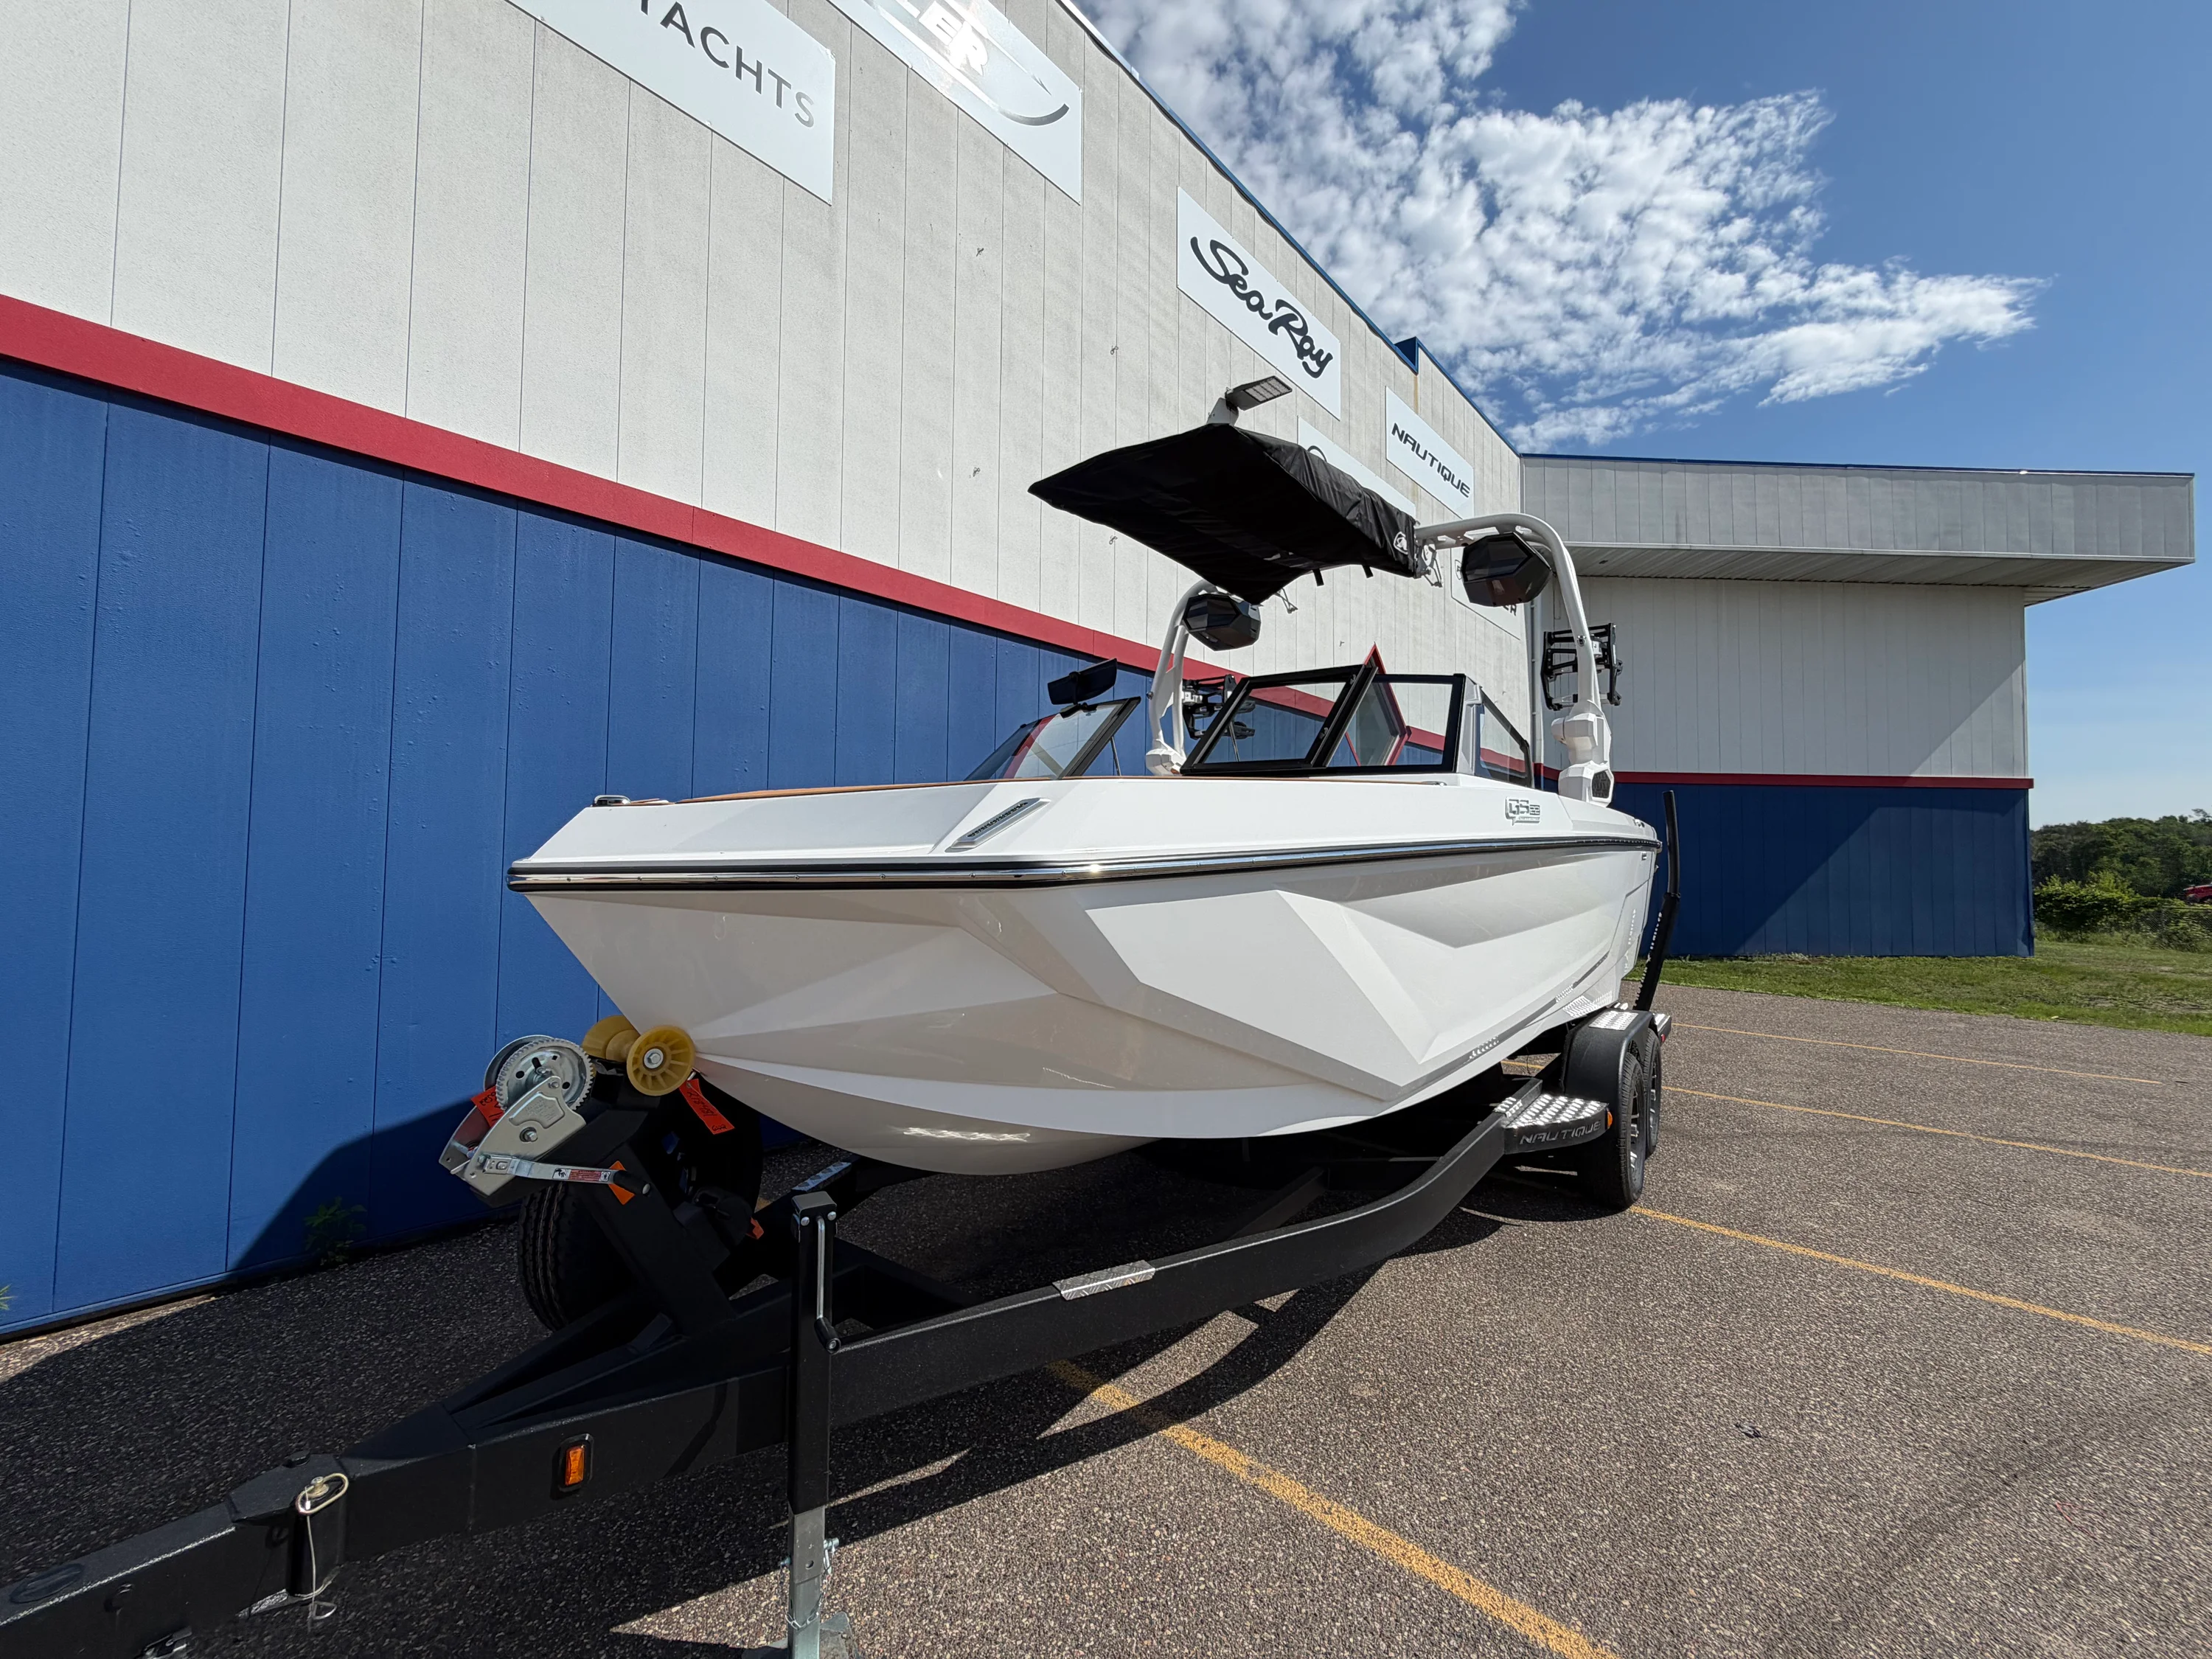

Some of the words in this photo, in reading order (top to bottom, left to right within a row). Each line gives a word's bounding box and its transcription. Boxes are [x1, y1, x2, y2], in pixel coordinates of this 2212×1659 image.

[641, 0, 815, 128] ACHTS
[1190, 237, 1273, 320] Sea
[1268, 299, 1333, 378] Ray
[1391, 422, 1471, 498] NAUTIQUE
[1519, 1121, 1601, 1145] NAUTIQUE
